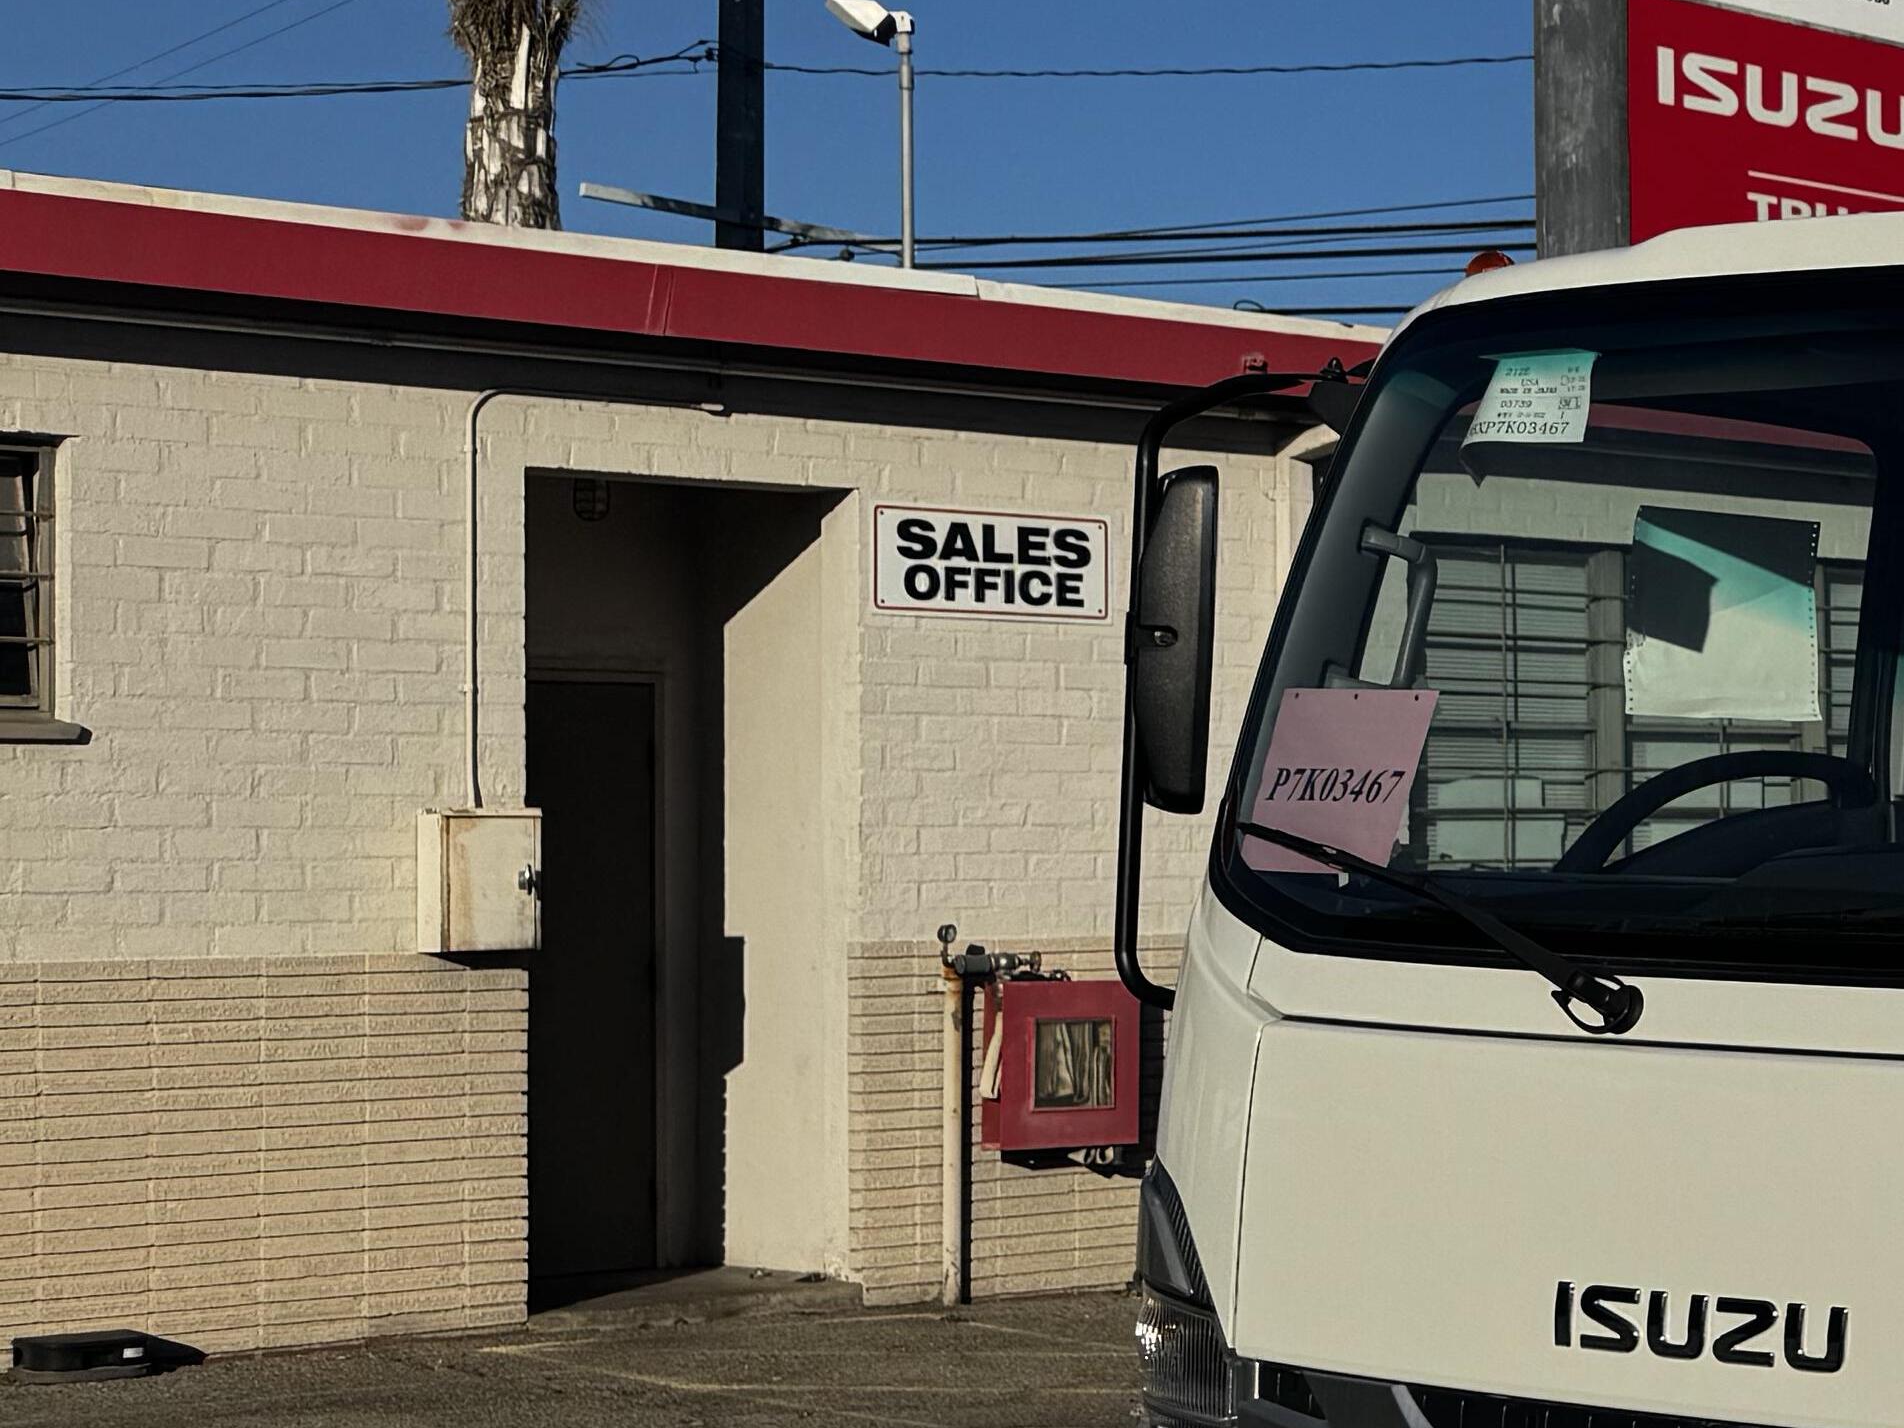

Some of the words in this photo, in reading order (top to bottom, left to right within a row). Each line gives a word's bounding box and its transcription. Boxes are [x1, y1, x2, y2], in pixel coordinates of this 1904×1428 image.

[896, 518, 1091, 569] SALES
[903, 564, 1085, 608] OFFICE
[1265, 767, 1407, 804] P7K03467
[1554, 1280, 1849, 1374] ISUZU
